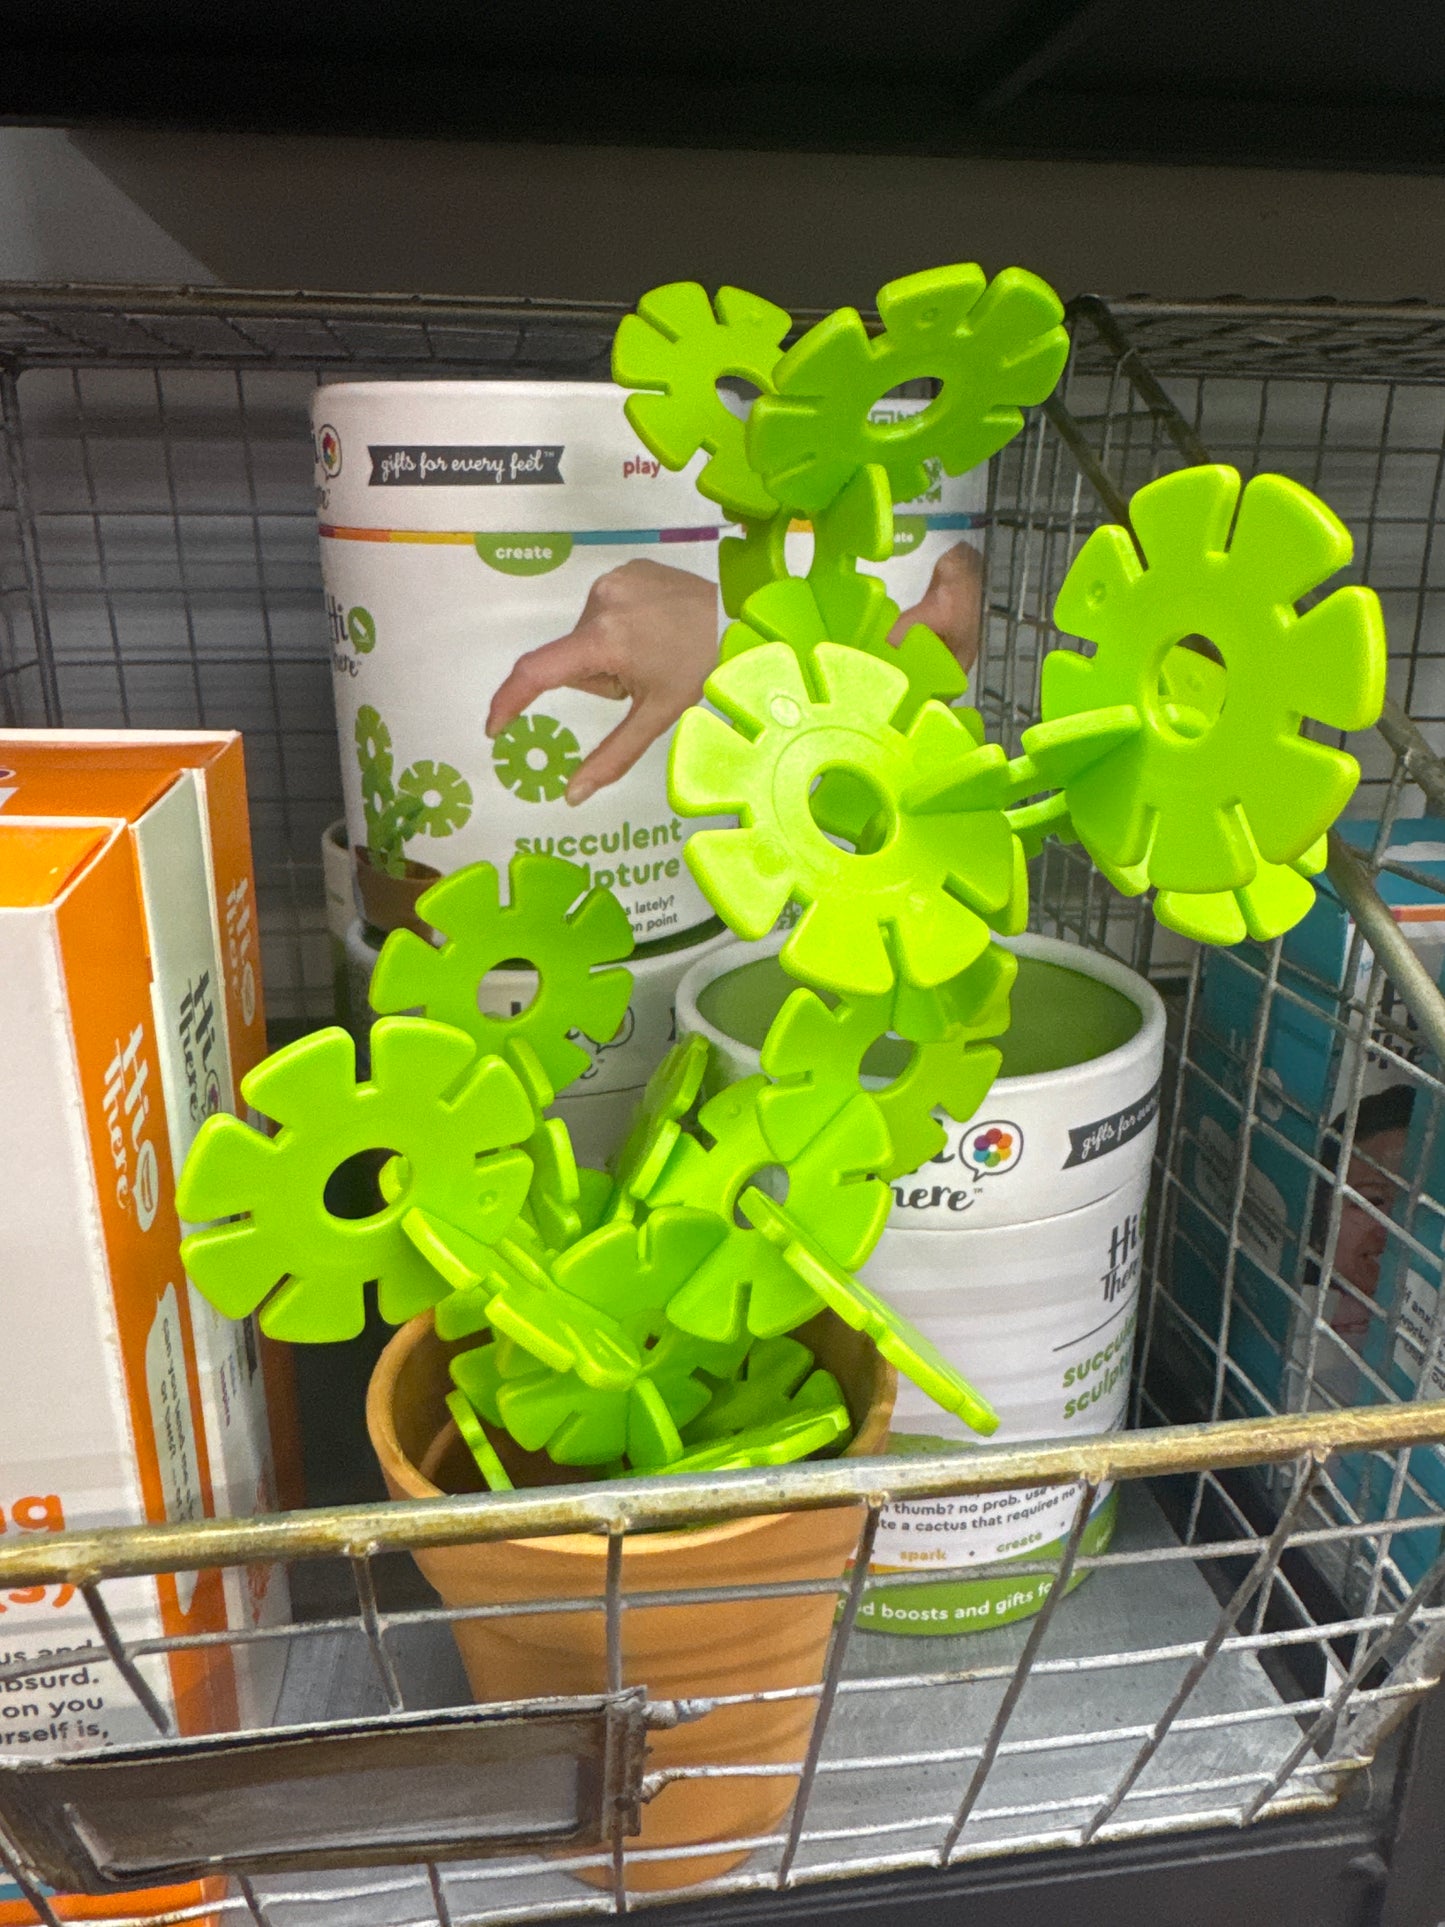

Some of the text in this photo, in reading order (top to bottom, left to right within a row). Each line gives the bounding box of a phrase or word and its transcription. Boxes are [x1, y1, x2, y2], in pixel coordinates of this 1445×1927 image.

[381, 450, 417, 483] gifts
[420, 451, 447, 480] for
[451, 457, 506, 484] every
[623, 454, 660, 479] play
[495, 545, 553, 561] create
[514, 818, 682, 857] succulent
[582, 857, 680, 890] lpture
[635, 894, 675, 914] lately?
[646, 912, 678, 932] point
[123, 1023, 149, 1153] Hi
[103, 1037, 129, 1211] There
[1108, 1213, 1139, 1269] Hi
[1101, 1257, 1139, 1303] Ther
[894, 1503, 954, 1516] thumb?
[959, 1503, 978, 1513] no
[983, 1494, 1021, 1513] prob.
[901, 1522, 910, 1531] a
[915, 1520, 967, 1532] cactus
[972, 1515, 1002, 1529] that
[1006, 1495, 1060, 1522] requires
[1061, 1487, 1076, 1501] no
[899, 1547, 947, 1561] spark
[996, 1532, 1043, 1553] create
[881, 1604, 949, 1621] boosts
[954, 1600, 990, 1619] and
[995, 1590, 1034, 1615] gifts
[1038, 1582, 1053, 1596] fo
[0, 1667, 100, 1693] bsurd.
[2, 1697, 104, 1719] on you
[0, 1719, 109, 1746] rself is,
